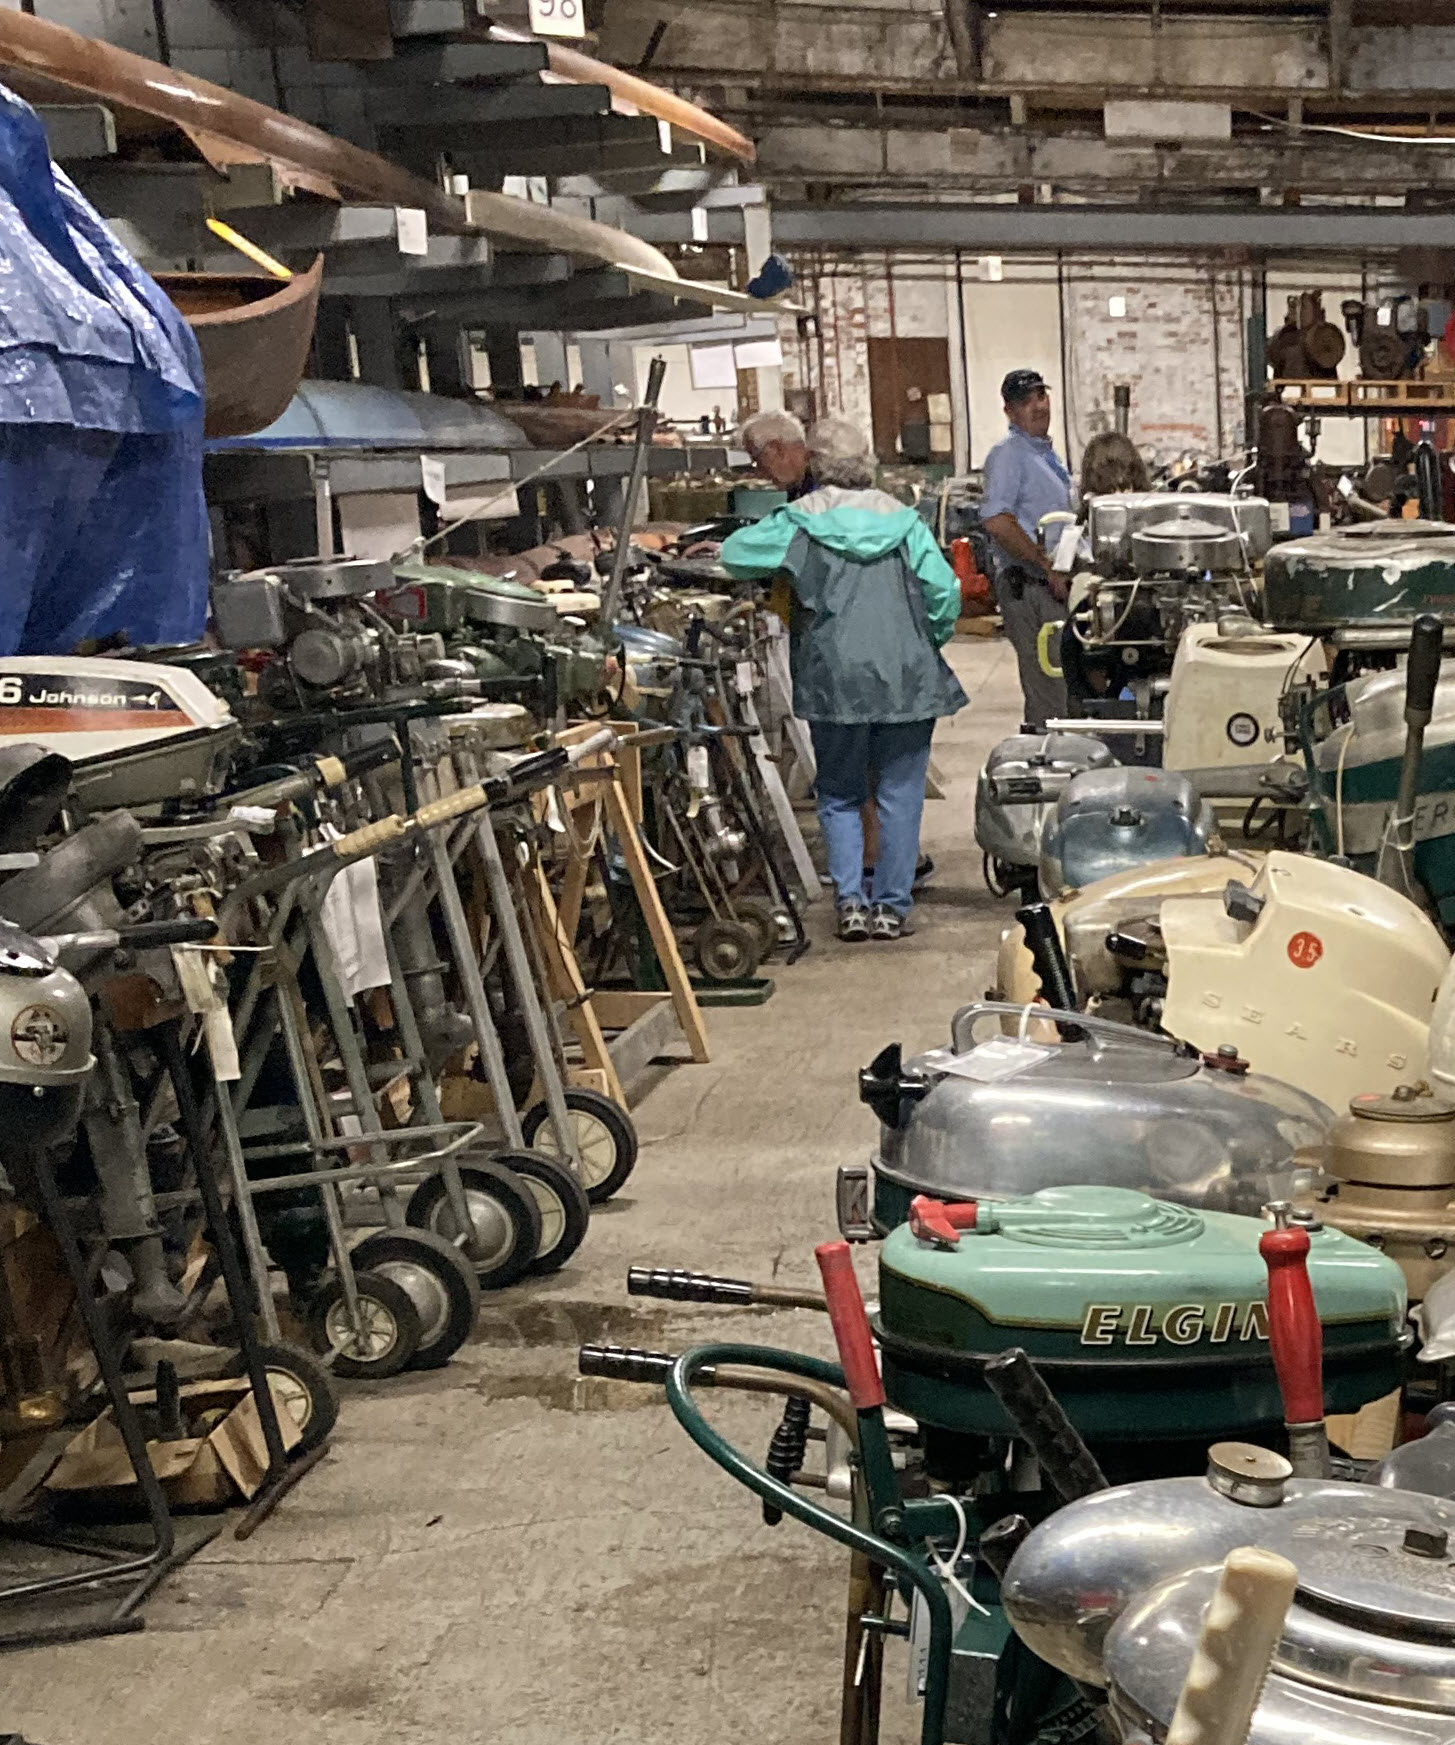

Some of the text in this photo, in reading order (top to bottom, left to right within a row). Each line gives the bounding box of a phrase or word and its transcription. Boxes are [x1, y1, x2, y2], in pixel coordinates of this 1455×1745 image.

[29, 689, 128, 705] Johnson
[1202, 990, 1408, 1071] SEARS
[1080, 1301, 1270, 1346] ELGIN
